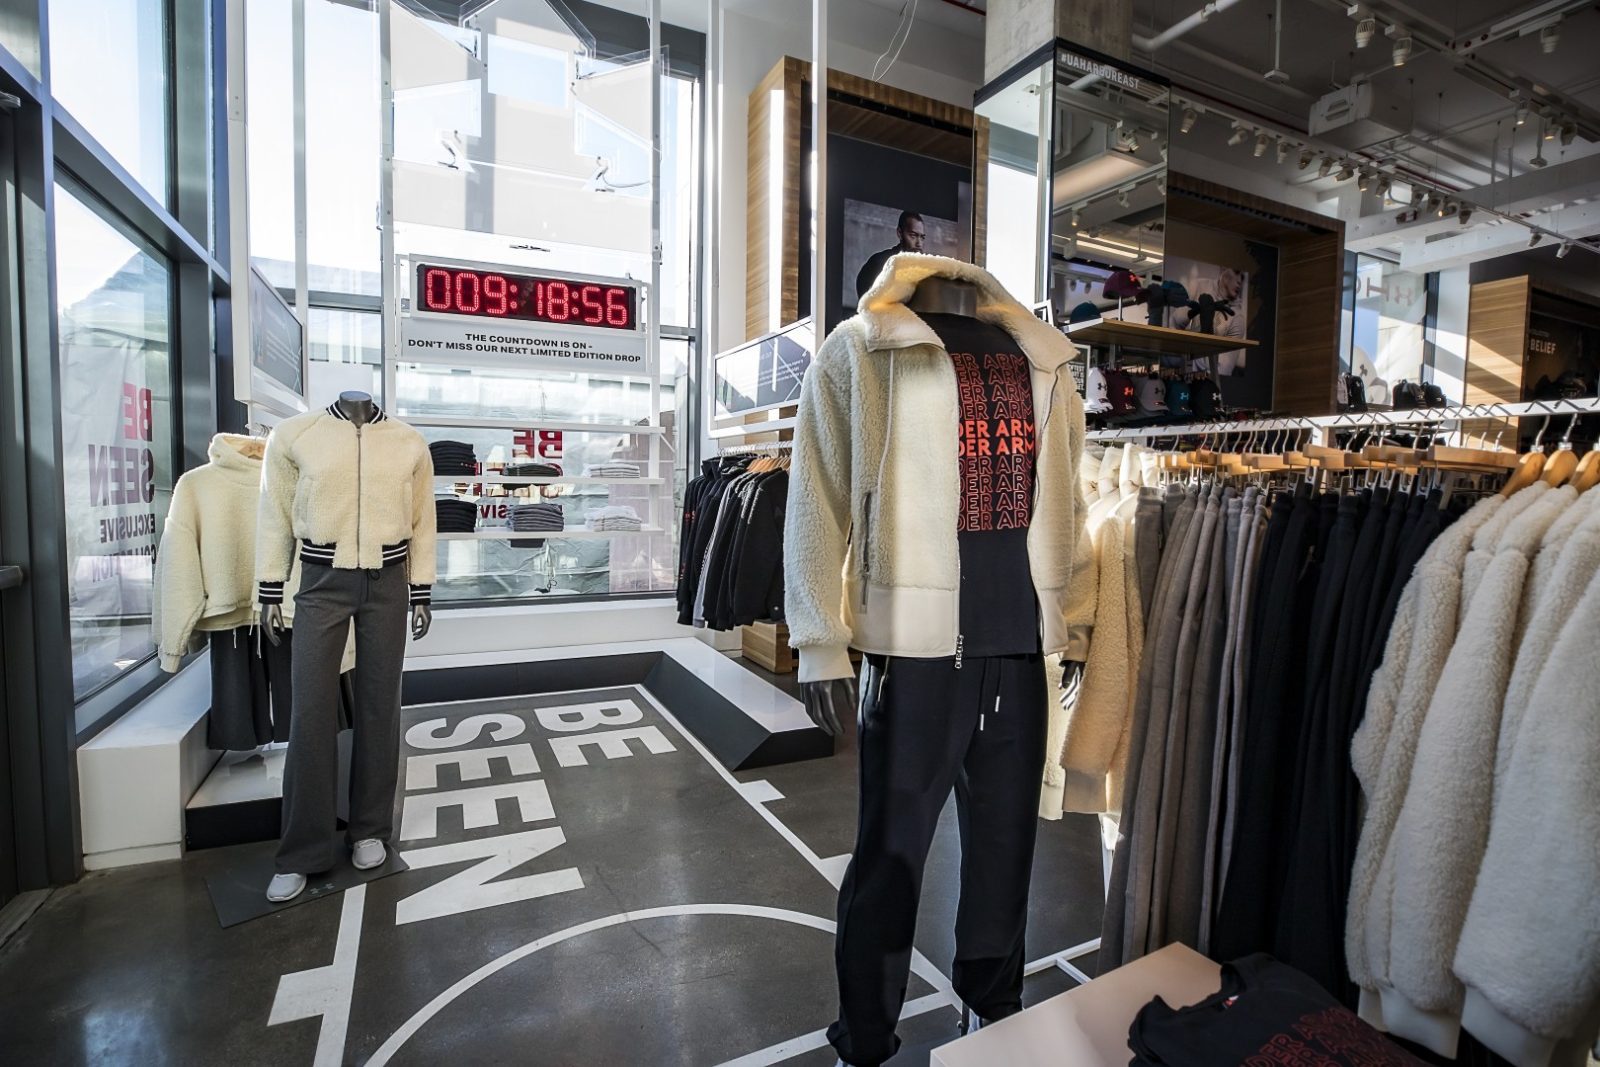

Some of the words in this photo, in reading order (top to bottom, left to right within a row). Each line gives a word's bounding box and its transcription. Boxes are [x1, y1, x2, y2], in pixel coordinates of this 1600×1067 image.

[408, 339, 443, 349] DON'T
[445, 341, 473, 351] MISS
[475, 343, 499, 353] OUR
[501, 346, 528, 355] NEXT
[530, 348, 571, 358] LIMITED
[573, 351, 613, 361] EDITION
[615, 354, 641, 363] DROP
[465, 333, 487, 342] THE
[489, 335, 558, 348] COUNTDOWN
[560, 341, 570, 349] IS
[572, 342, 587, 350] ON
[1530, 338, 1557, 354] BELIEF
[959, 401, 990, 420] ER
[533, 698, 678, 768] BE
[395, 712, 586, 926] SEEN
